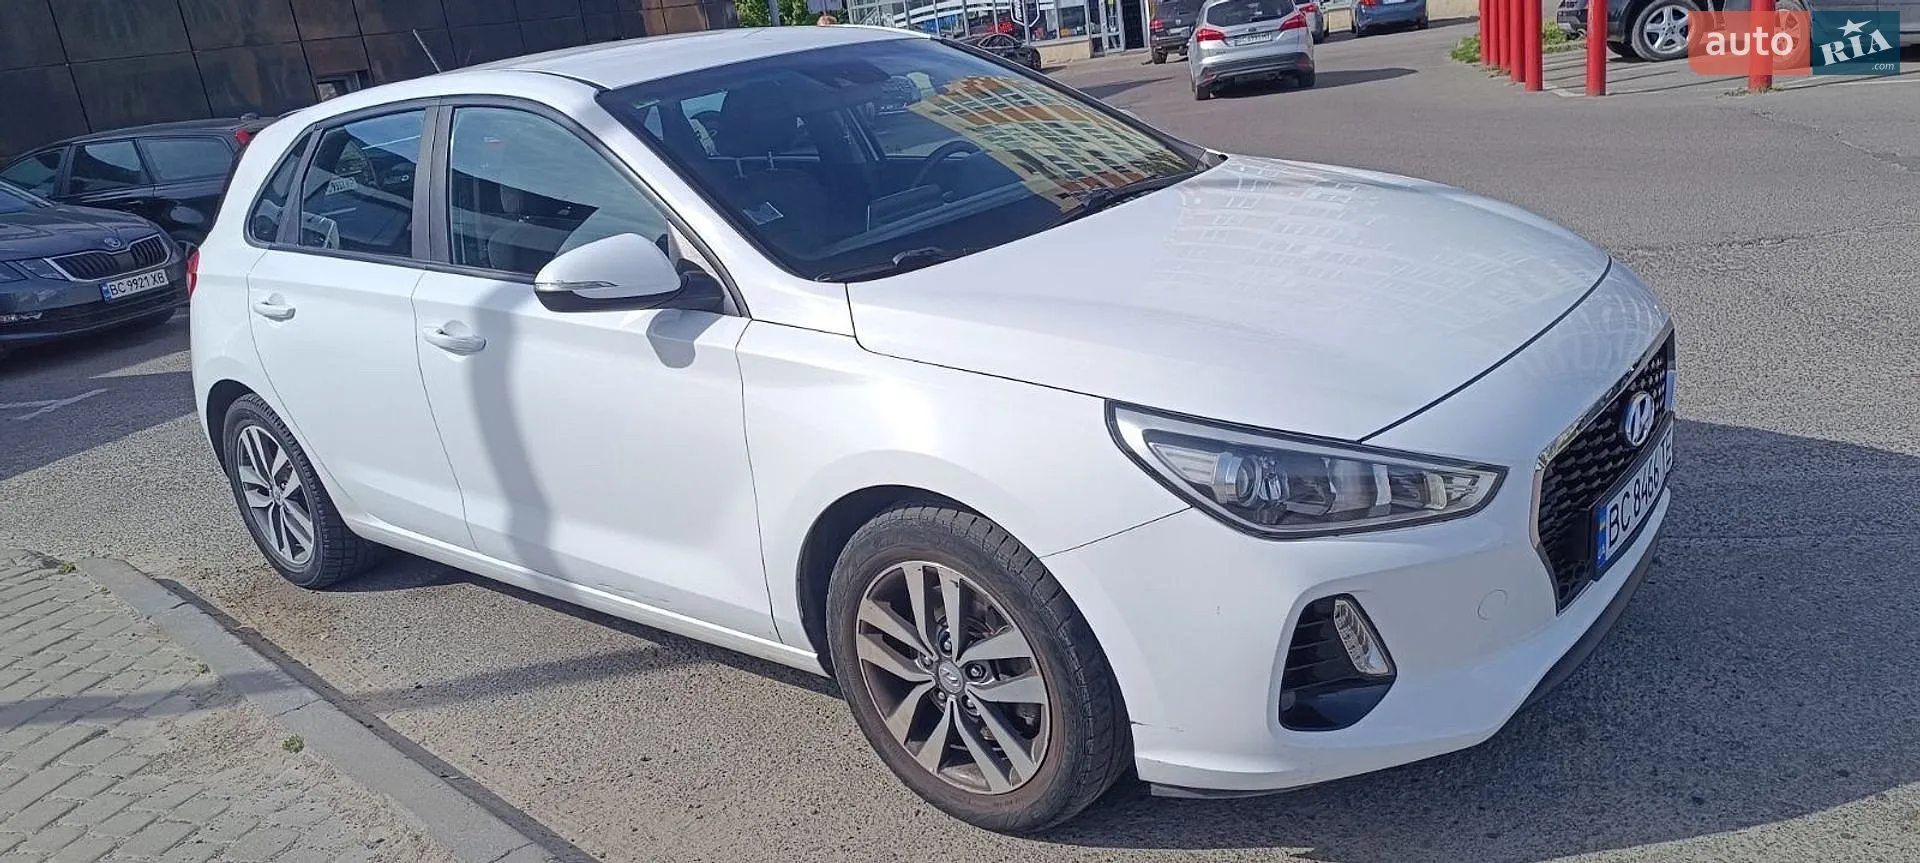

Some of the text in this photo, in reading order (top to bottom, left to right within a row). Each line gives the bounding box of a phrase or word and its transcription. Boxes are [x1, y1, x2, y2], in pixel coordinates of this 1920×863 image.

[110, 272, 165, 295] BC 9921 XB
[1609, 492, 1631, 548] BC
[1634, 452, 1659, 517] 8466
